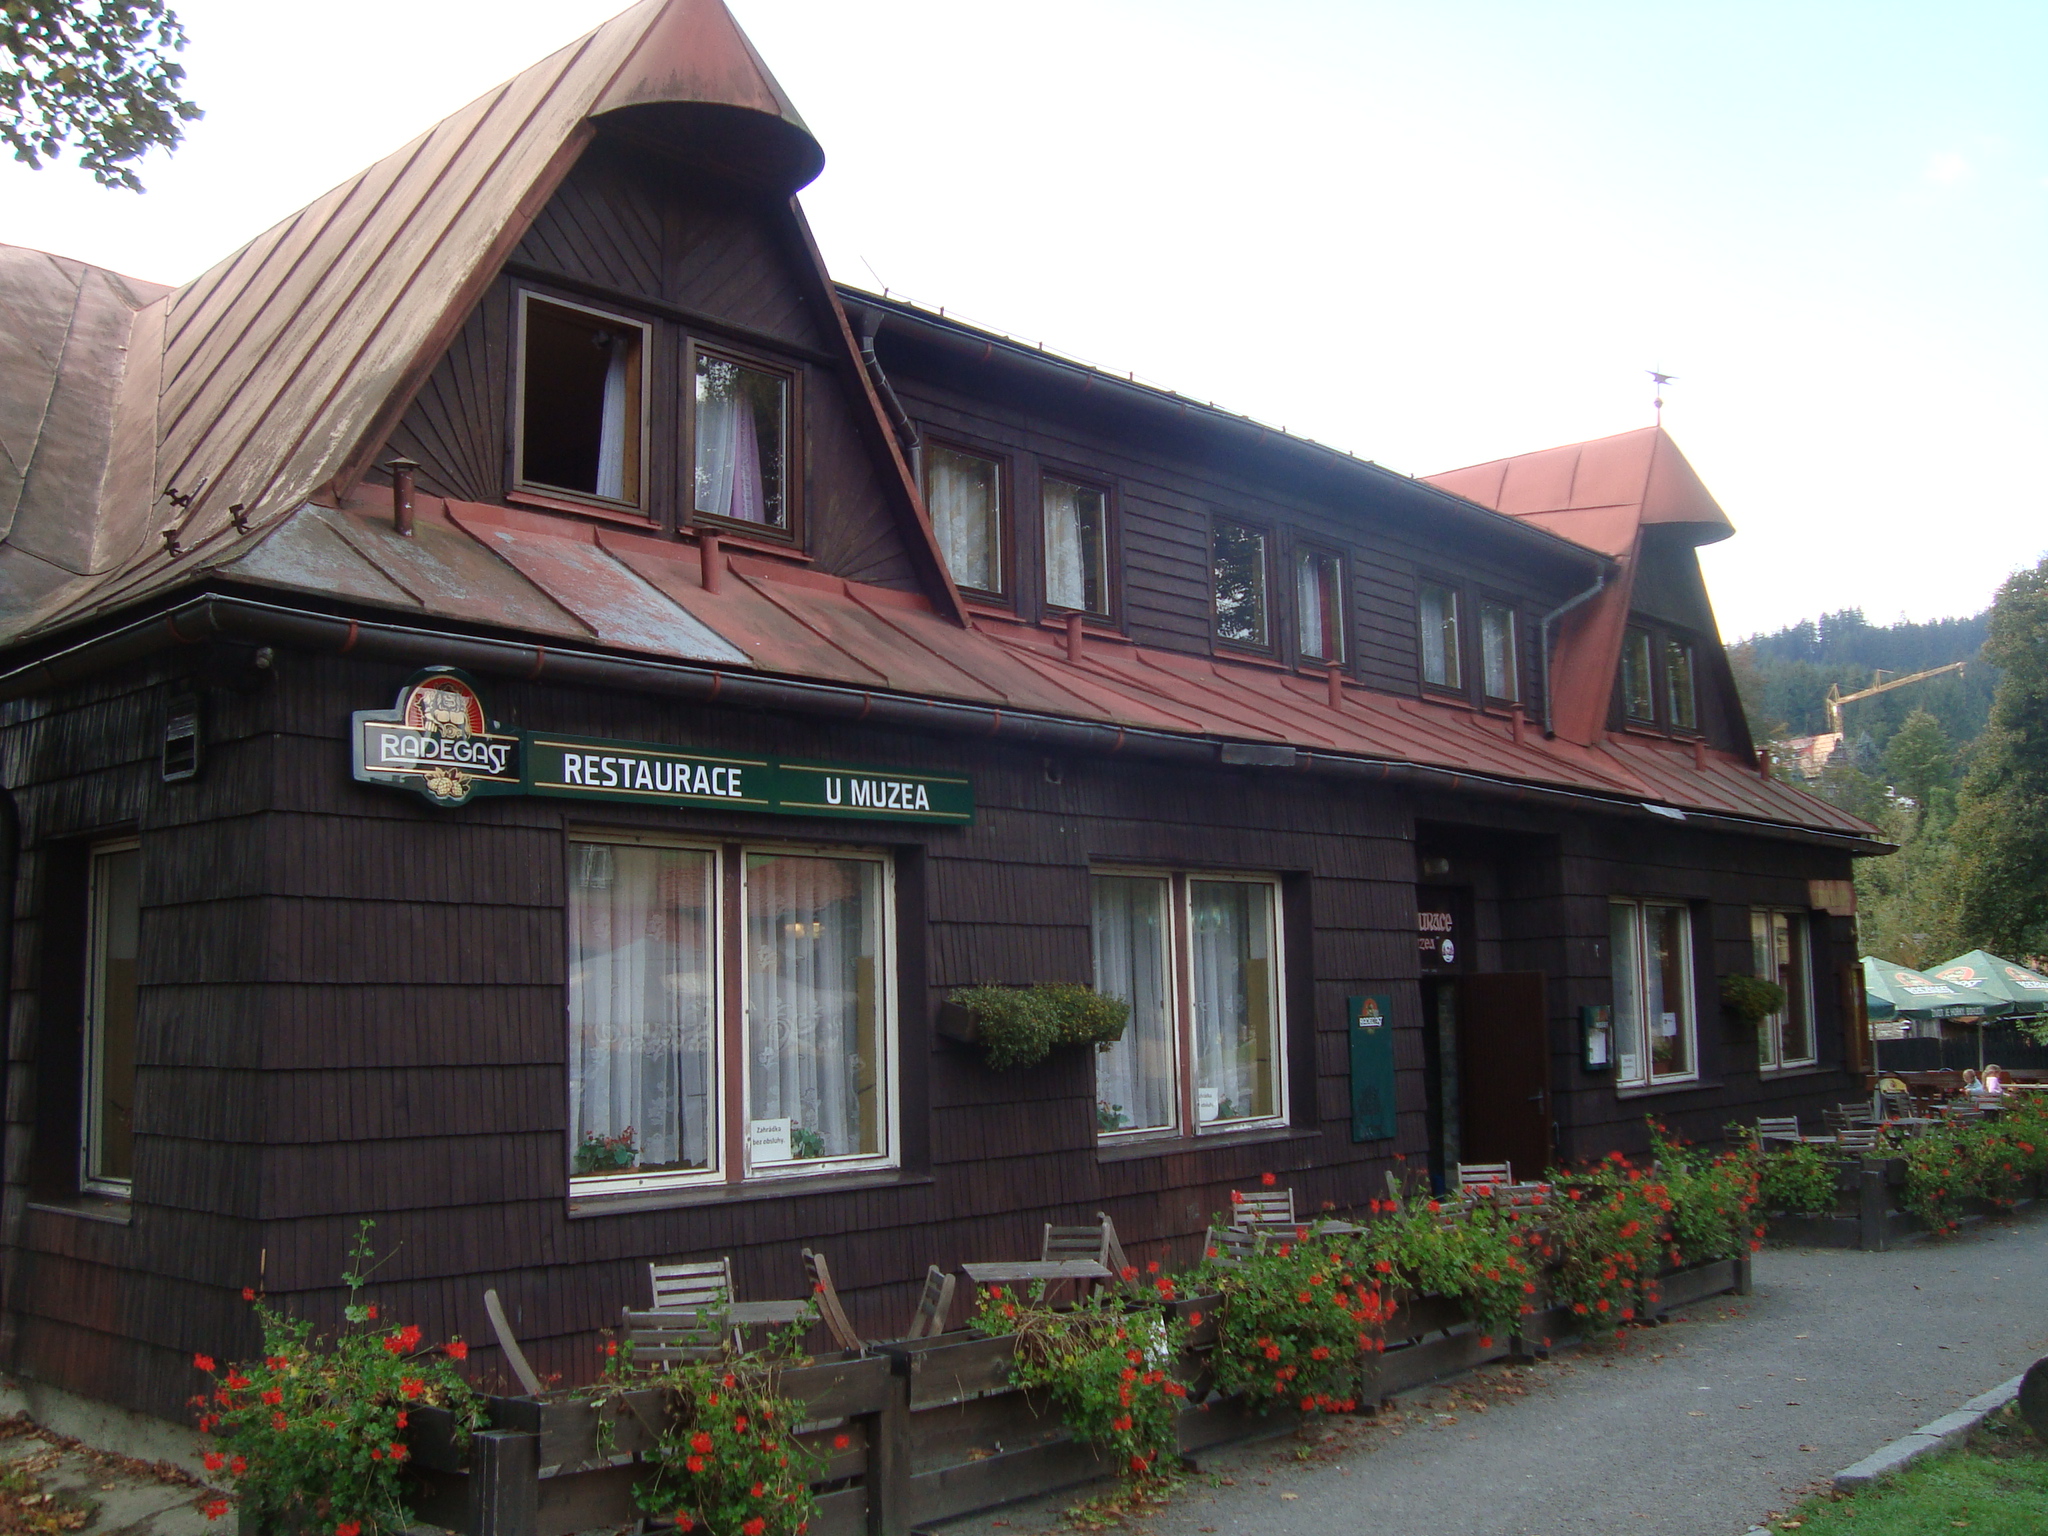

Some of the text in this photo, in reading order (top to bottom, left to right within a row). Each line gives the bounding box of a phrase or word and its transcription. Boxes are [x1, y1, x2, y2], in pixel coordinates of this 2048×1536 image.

[380, 733, 511, 774] RADEGAST
[564, 753, 930, 811] RESTAURACE U MUZEA
